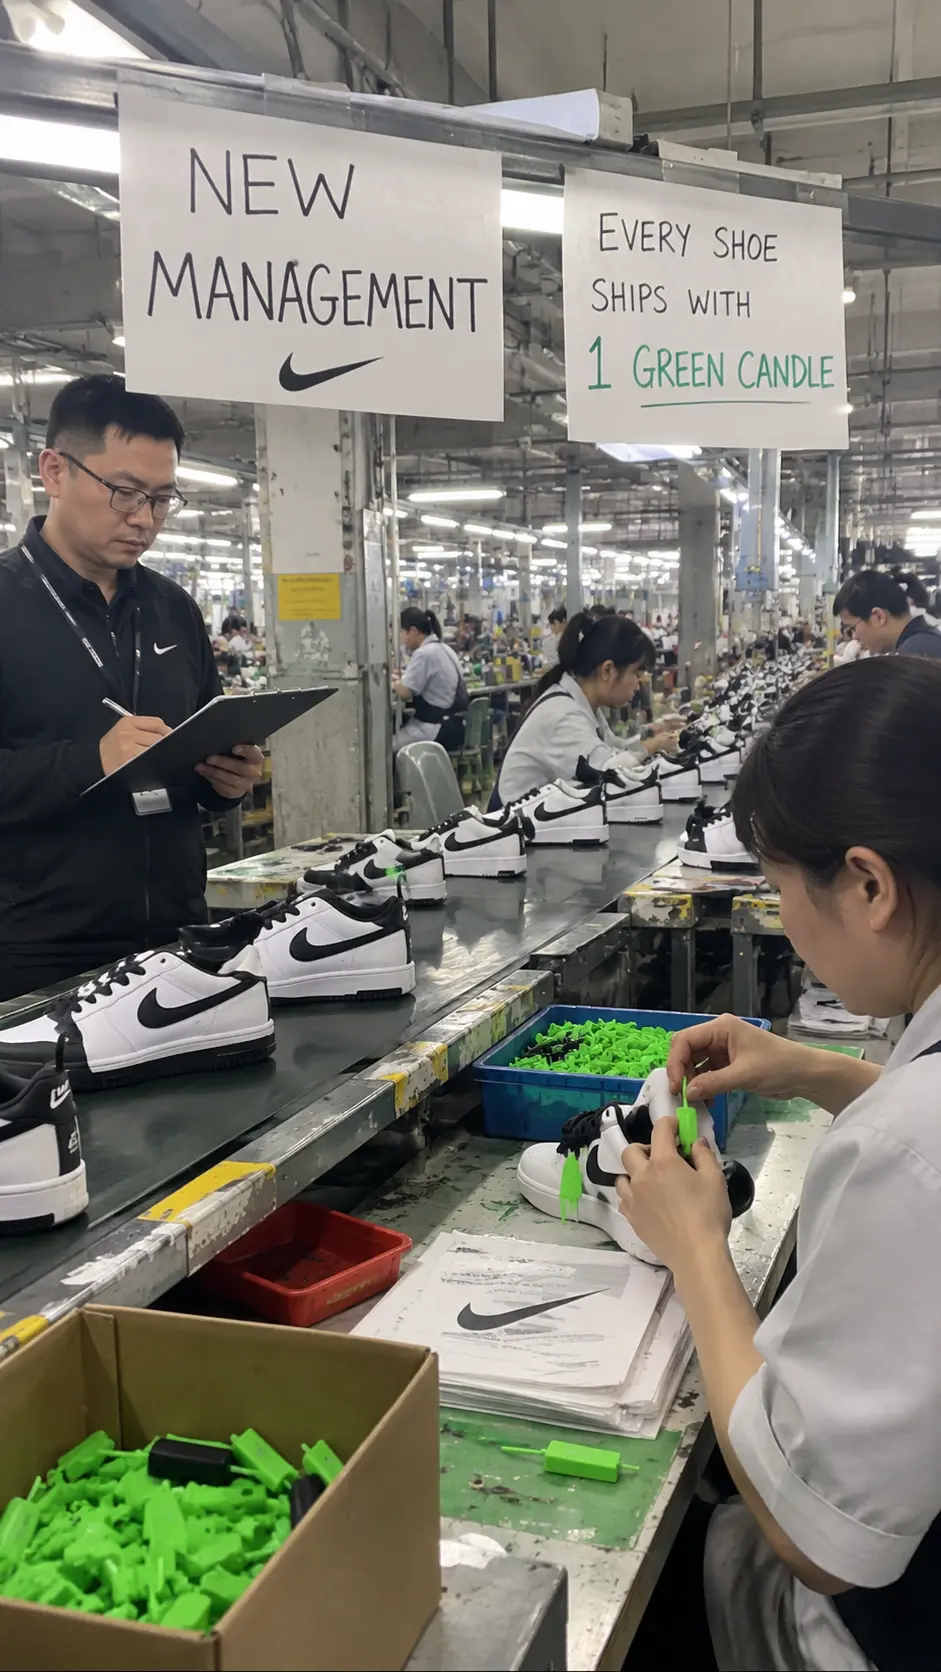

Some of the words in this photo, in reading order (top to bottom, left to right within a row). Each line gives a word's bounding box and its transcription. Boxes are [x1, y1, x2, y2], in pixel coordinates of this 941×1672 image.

[190, 147, 355, 219] NEW
[600, 212, 691, 257] EVERY
[713, 226, 778, 262] SHOE
[147, 250, 489, 332] MANAGEMENT
[591, 278, 668, 313] SHIPS
[688, 289, 751, 318] WITH
[588, 336, 612, 390] 1
[633, 344, 725, 388] GREEN
[737, 351, 835, 389] CANDLE
